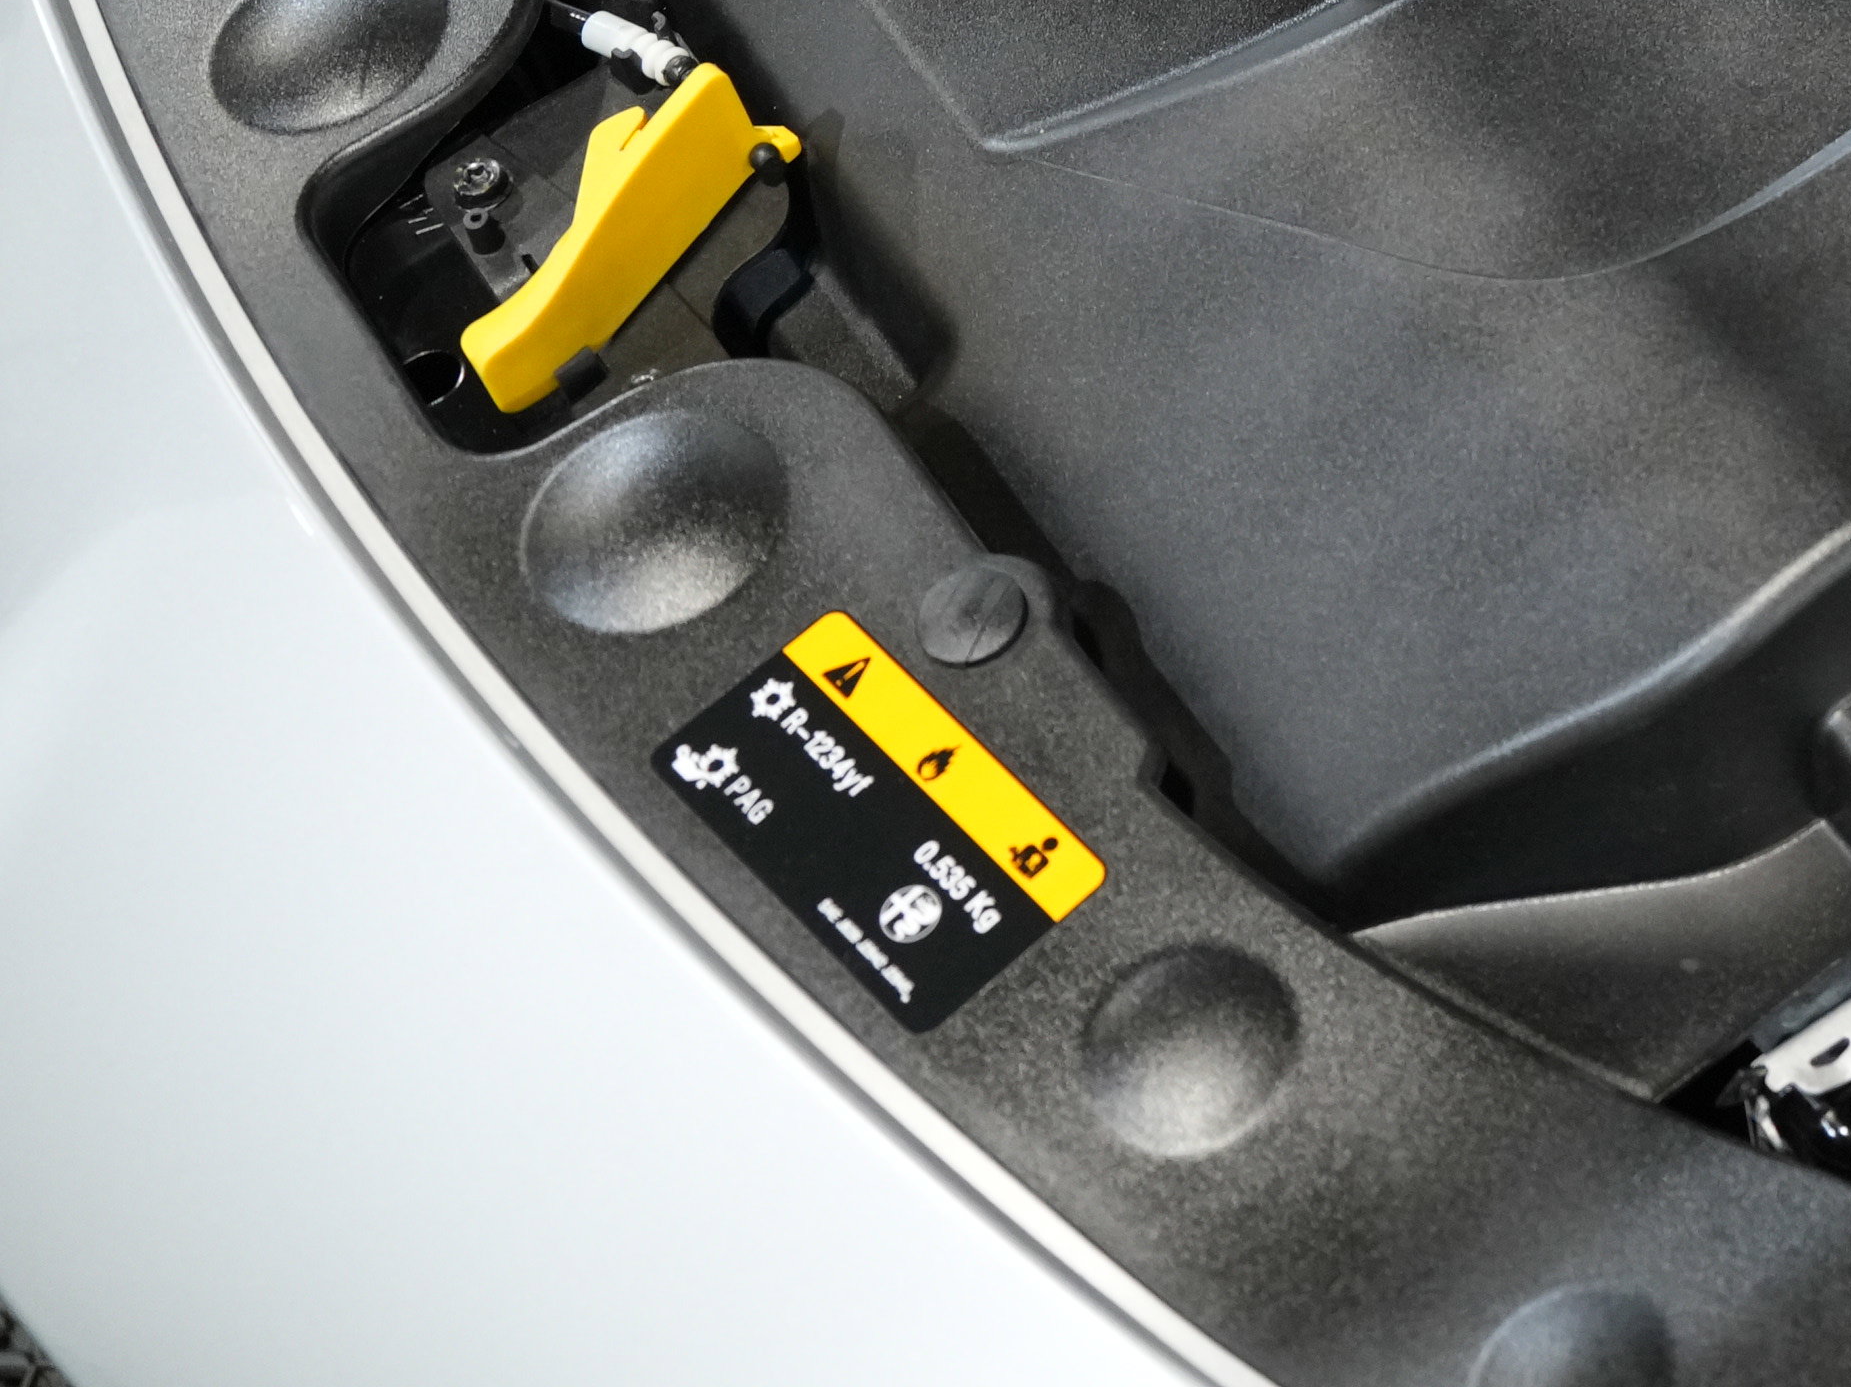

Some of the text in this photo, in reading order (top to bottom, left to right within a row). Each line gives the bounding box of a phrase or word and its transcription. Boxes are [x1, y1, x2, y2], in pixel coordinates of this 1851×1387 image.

[781, 705, 875, 797] R-1234yf
[724, 774, 775, 825] PAG
[913, 839, 1002, 933] 0.535 Kg
